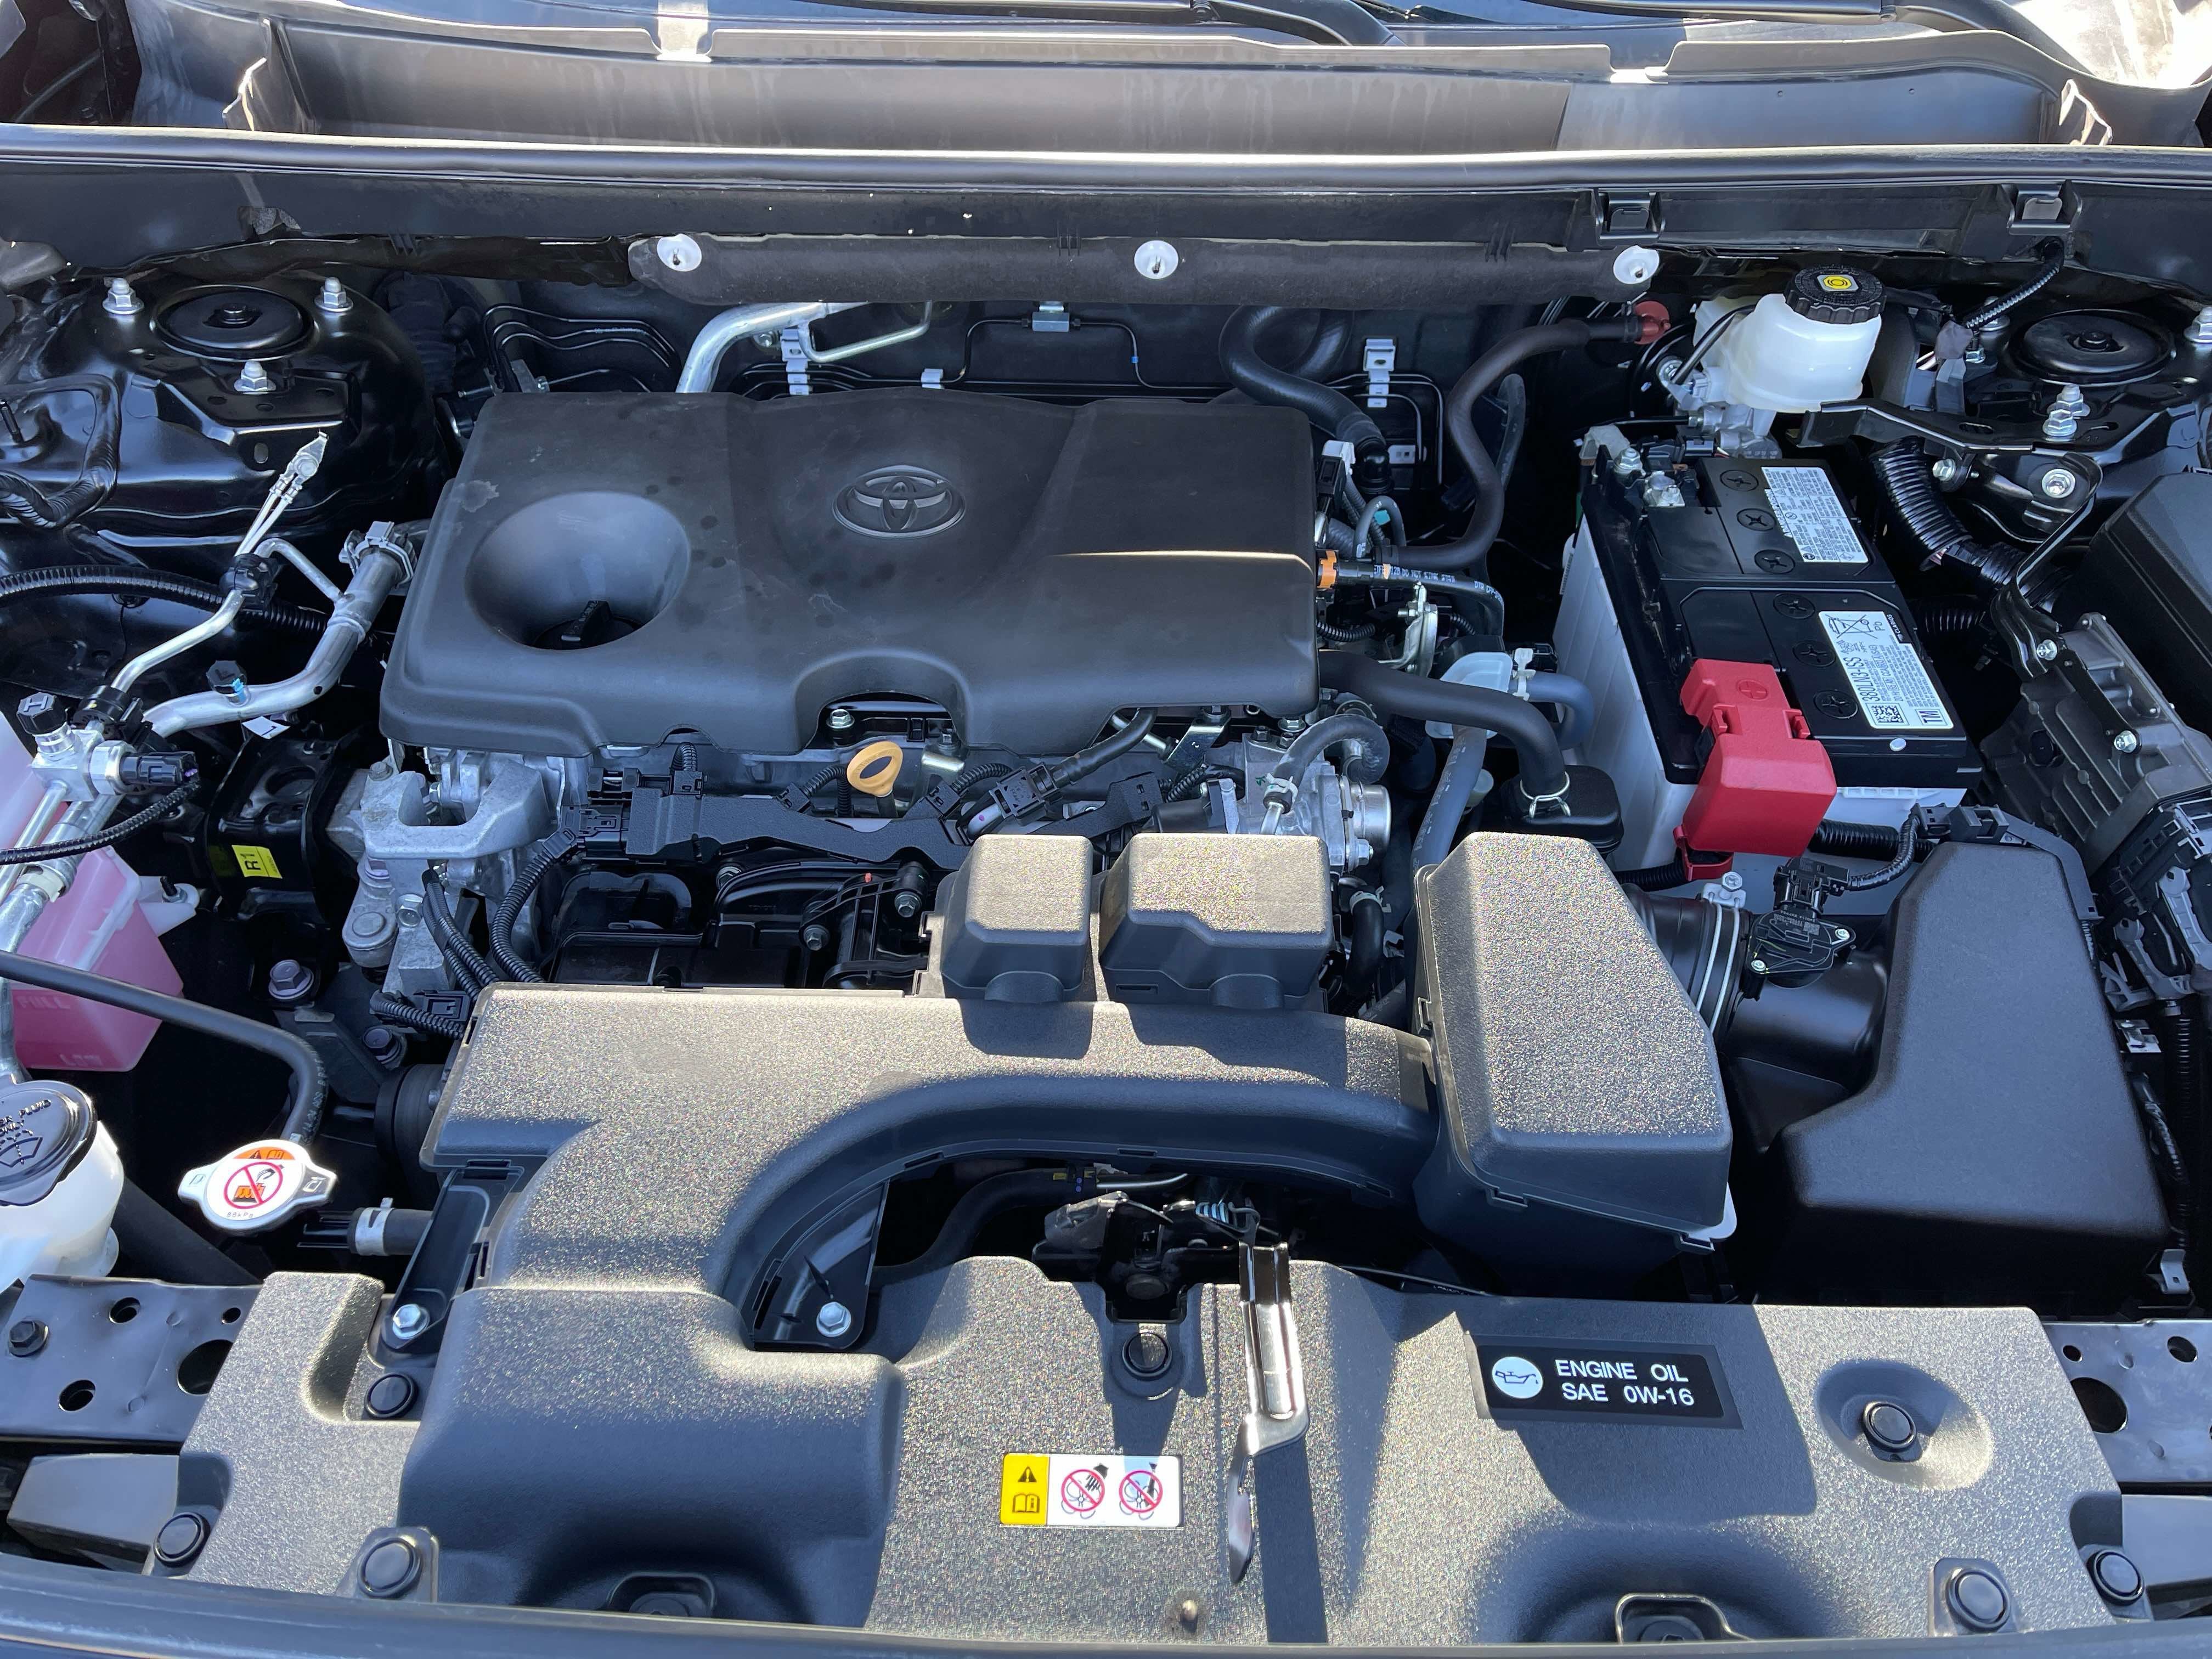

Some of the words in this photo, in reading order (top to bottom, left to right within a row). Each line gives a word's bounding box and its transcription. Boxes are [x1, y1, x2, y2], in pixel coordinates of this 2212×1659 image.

[1871, 621, 1885, 630] Pb
[1843, 657, 1880, 701] 380LN3-ISS
[24, 695, 48, 712] H
[1918, 710, 1943, 723] TM
[240, 853, 261, 870] R1
[1555, 1359, 1637, 1380] ENGINE
[1650, 1363, 1689, 1382] OIL
[1562, 1382, 1609, 1402] SAE
[1623, 1385, 1695, 1406] 0W-16
